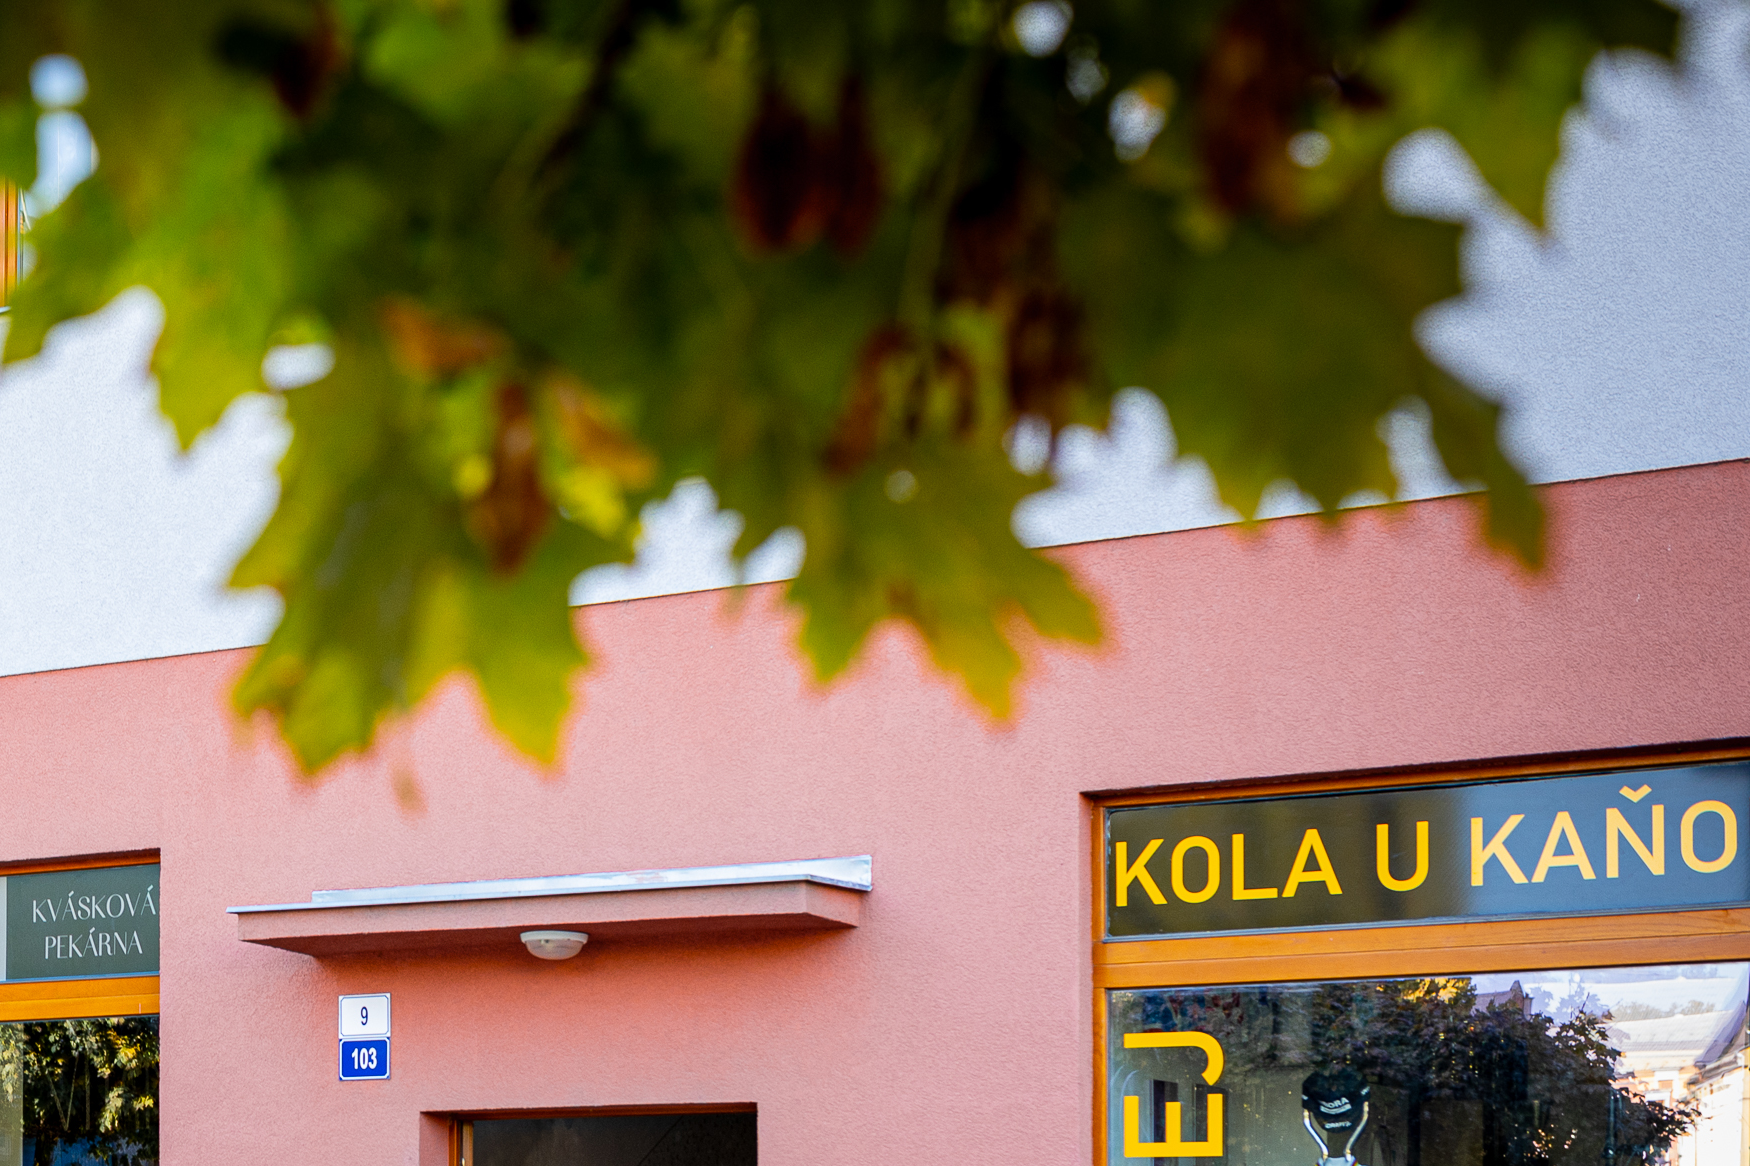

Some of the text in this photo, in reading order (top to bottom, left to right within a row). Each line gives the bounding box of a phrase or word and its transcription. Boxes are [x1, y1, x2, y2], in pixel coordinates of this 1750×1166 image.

[1115, 784, 1737, 908] KOLA U KAŇO
[32, 884, 156, 924] KVÁSKOVÁ
[44, 927, 143, 960] PEKÁRNA
[360, 1006, 369, 1026] 9
[351, 1047, 377, 1070] 103
